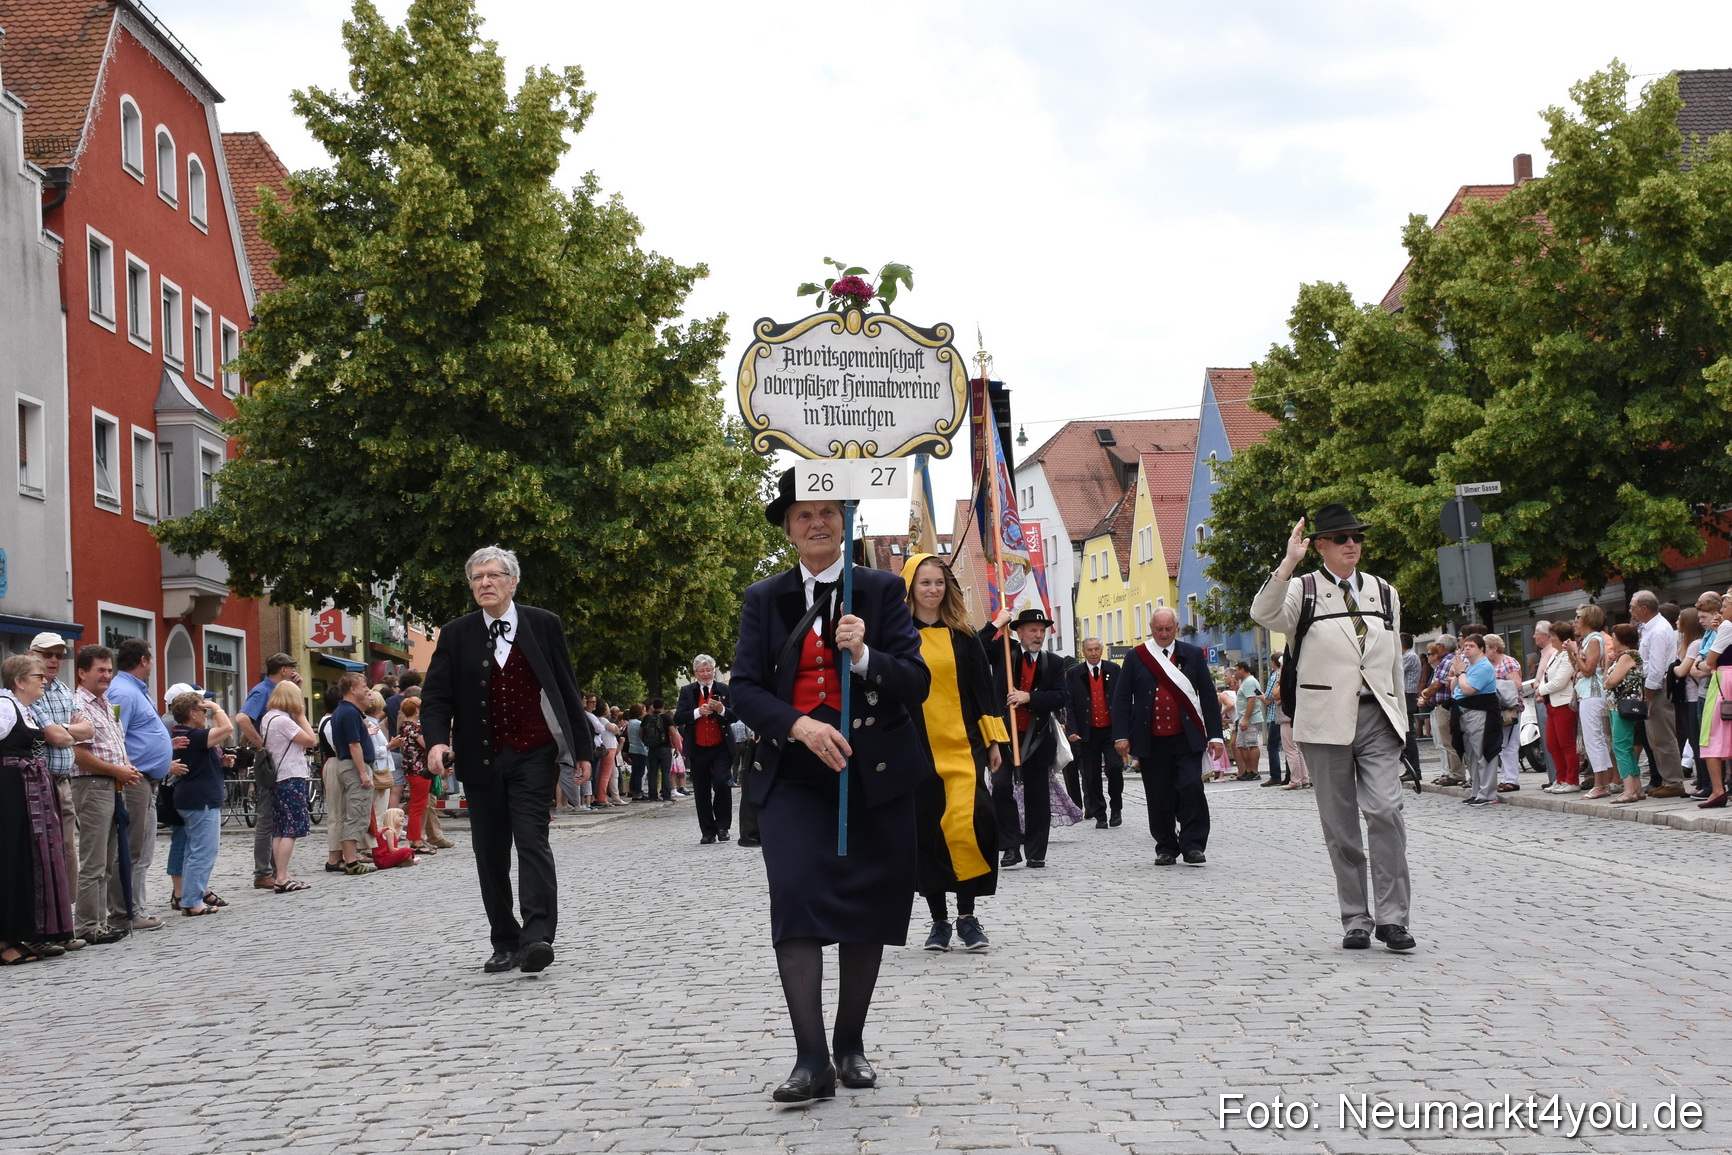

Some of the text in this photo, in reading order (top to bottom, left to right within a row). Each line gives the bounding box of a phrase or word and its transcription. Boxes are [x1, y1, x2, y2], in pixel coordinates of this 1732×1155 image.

[764, 372, 941, 402] oberpfälzer Heimatvereine
[803, 402, 897, 432] in München
[807, 473, 834, 492] 26
[870, 467, 897, 486] 27
[1464, 484, 1498, 493] Ulmer Gasse
[1025, 526, 1037, 553] K&L
[1098, 594, 1111, 608] HOTEL
